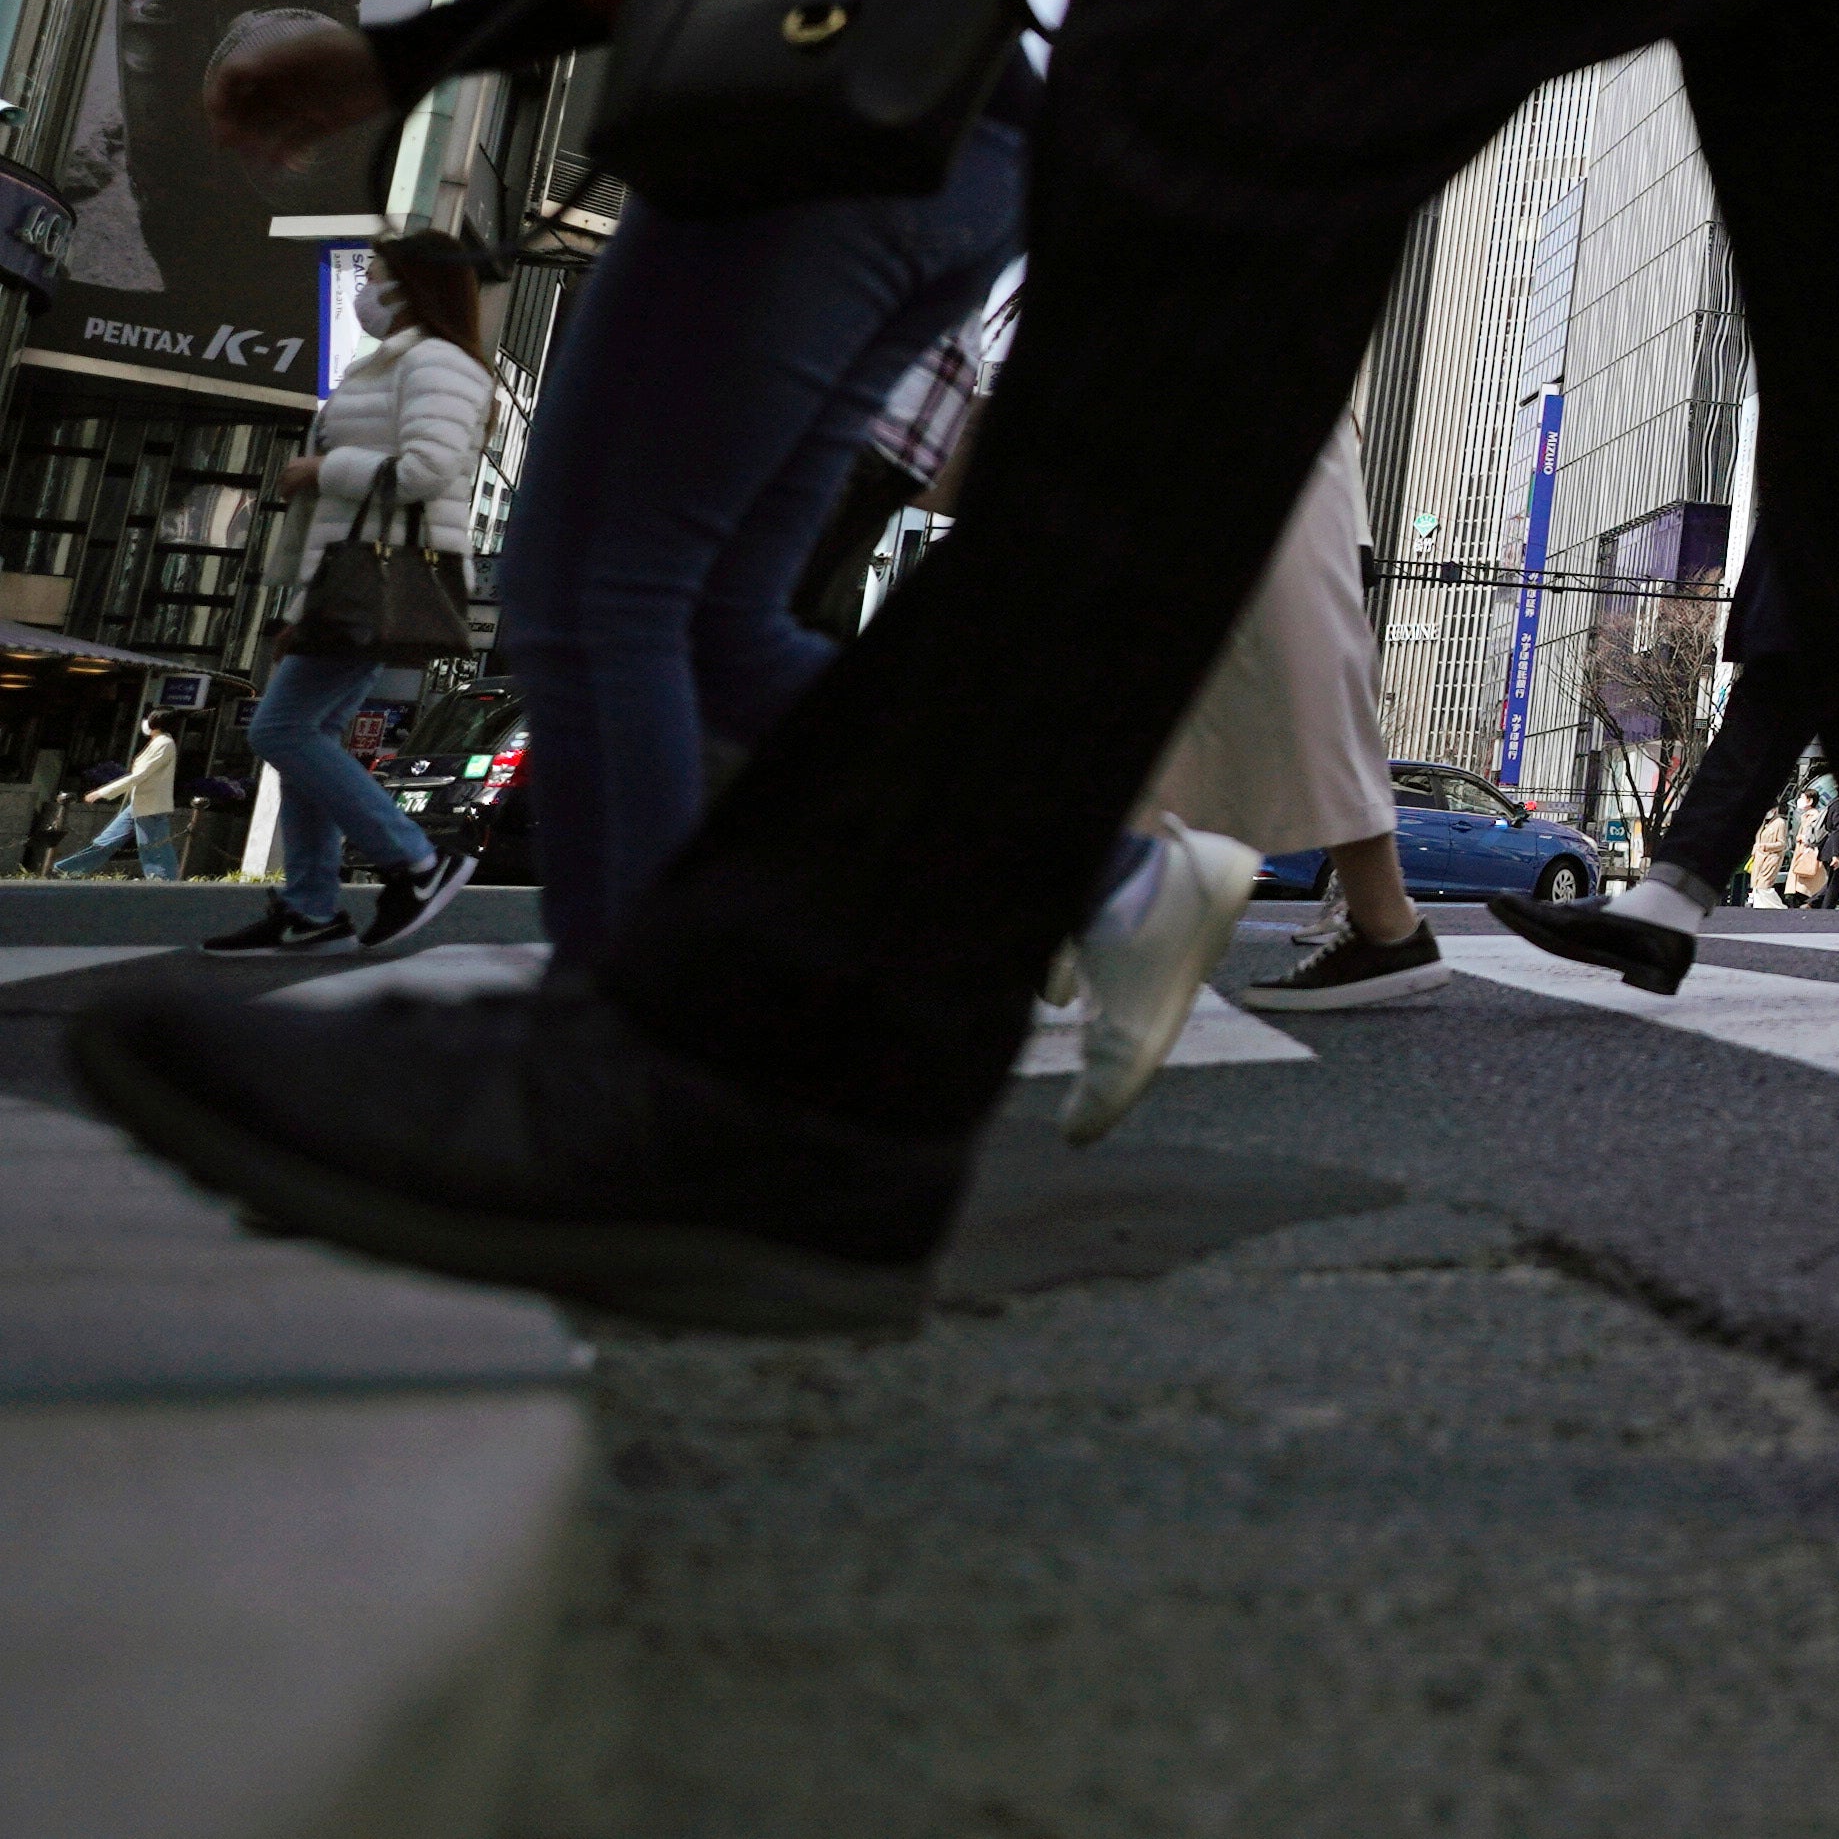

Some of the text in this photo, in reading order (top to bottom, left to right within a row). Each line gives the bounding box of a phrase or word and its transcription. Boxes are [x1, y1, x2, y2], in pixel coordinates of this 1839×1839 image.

[352, 253, 366, 295] SALO
[84, 316, 194, 356] PENTAX
[202, 324, 304, 373] K-1
[1543, 431, 1558, 476] MIZUHO
